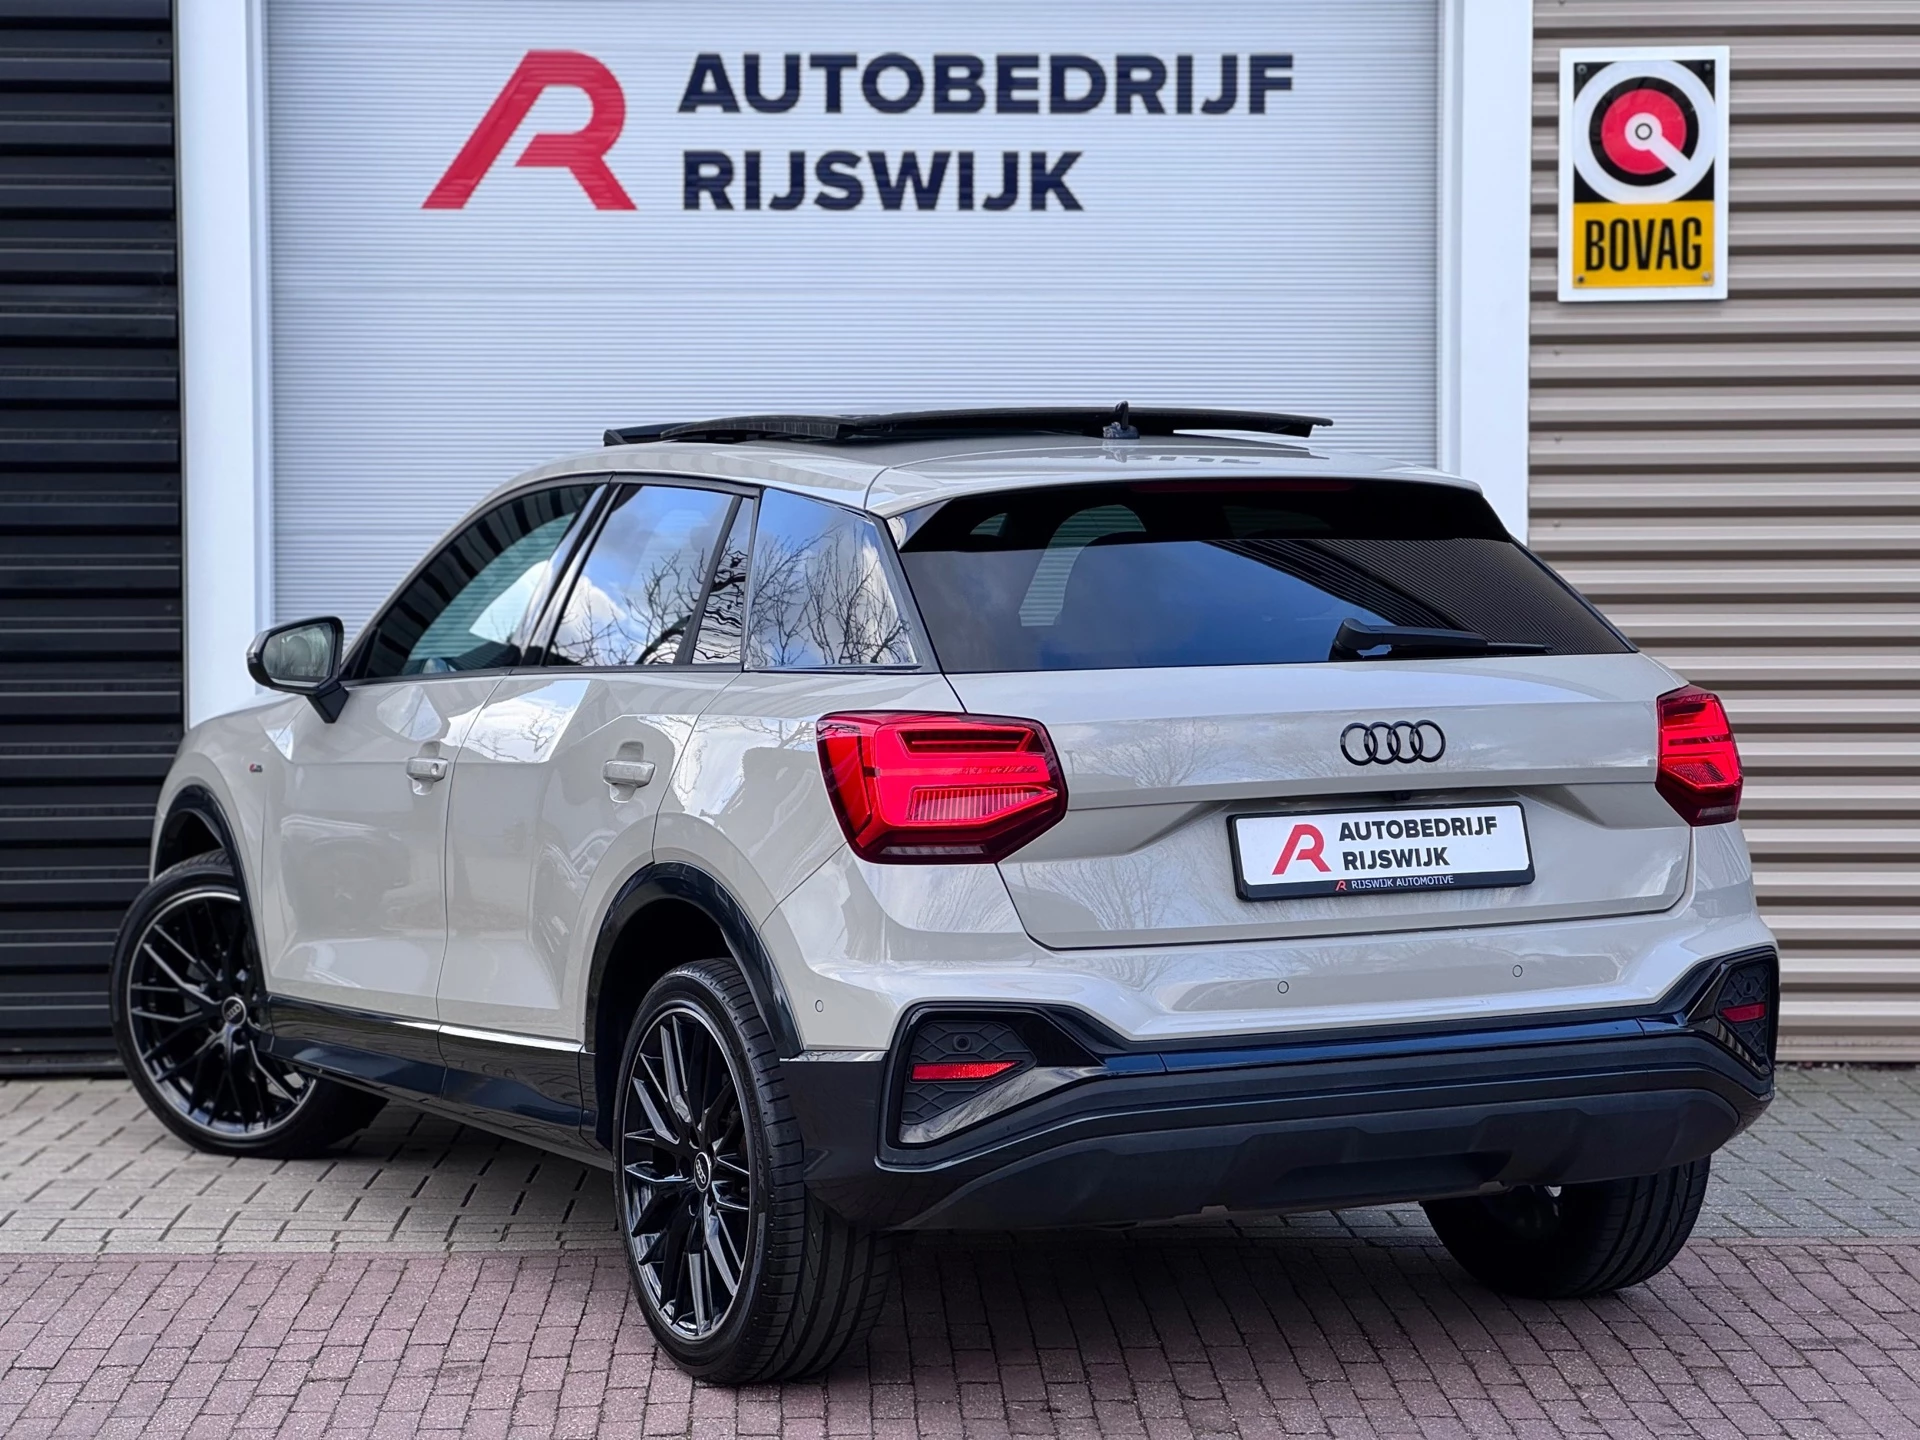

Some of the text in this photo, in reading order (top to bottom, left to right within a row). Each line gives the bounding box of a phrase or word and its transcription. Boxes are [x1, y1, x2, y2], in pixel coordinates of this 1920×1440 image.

[678, 52, 1294, 115] AUTOBEDRIJF
[682, 150, 1084, 212] RIJSWIJK
[1584, 216, 1703, 272] BOVAG
[1338, 815, 1498, 842] AUTOBEDRIJF
[1342, 847, 1450, 871] RIJSWIJK
[1351, 878, 1394, 889] RIJSWIJK
[1396, 875, 1455, 887] AUTOMOTIVE
